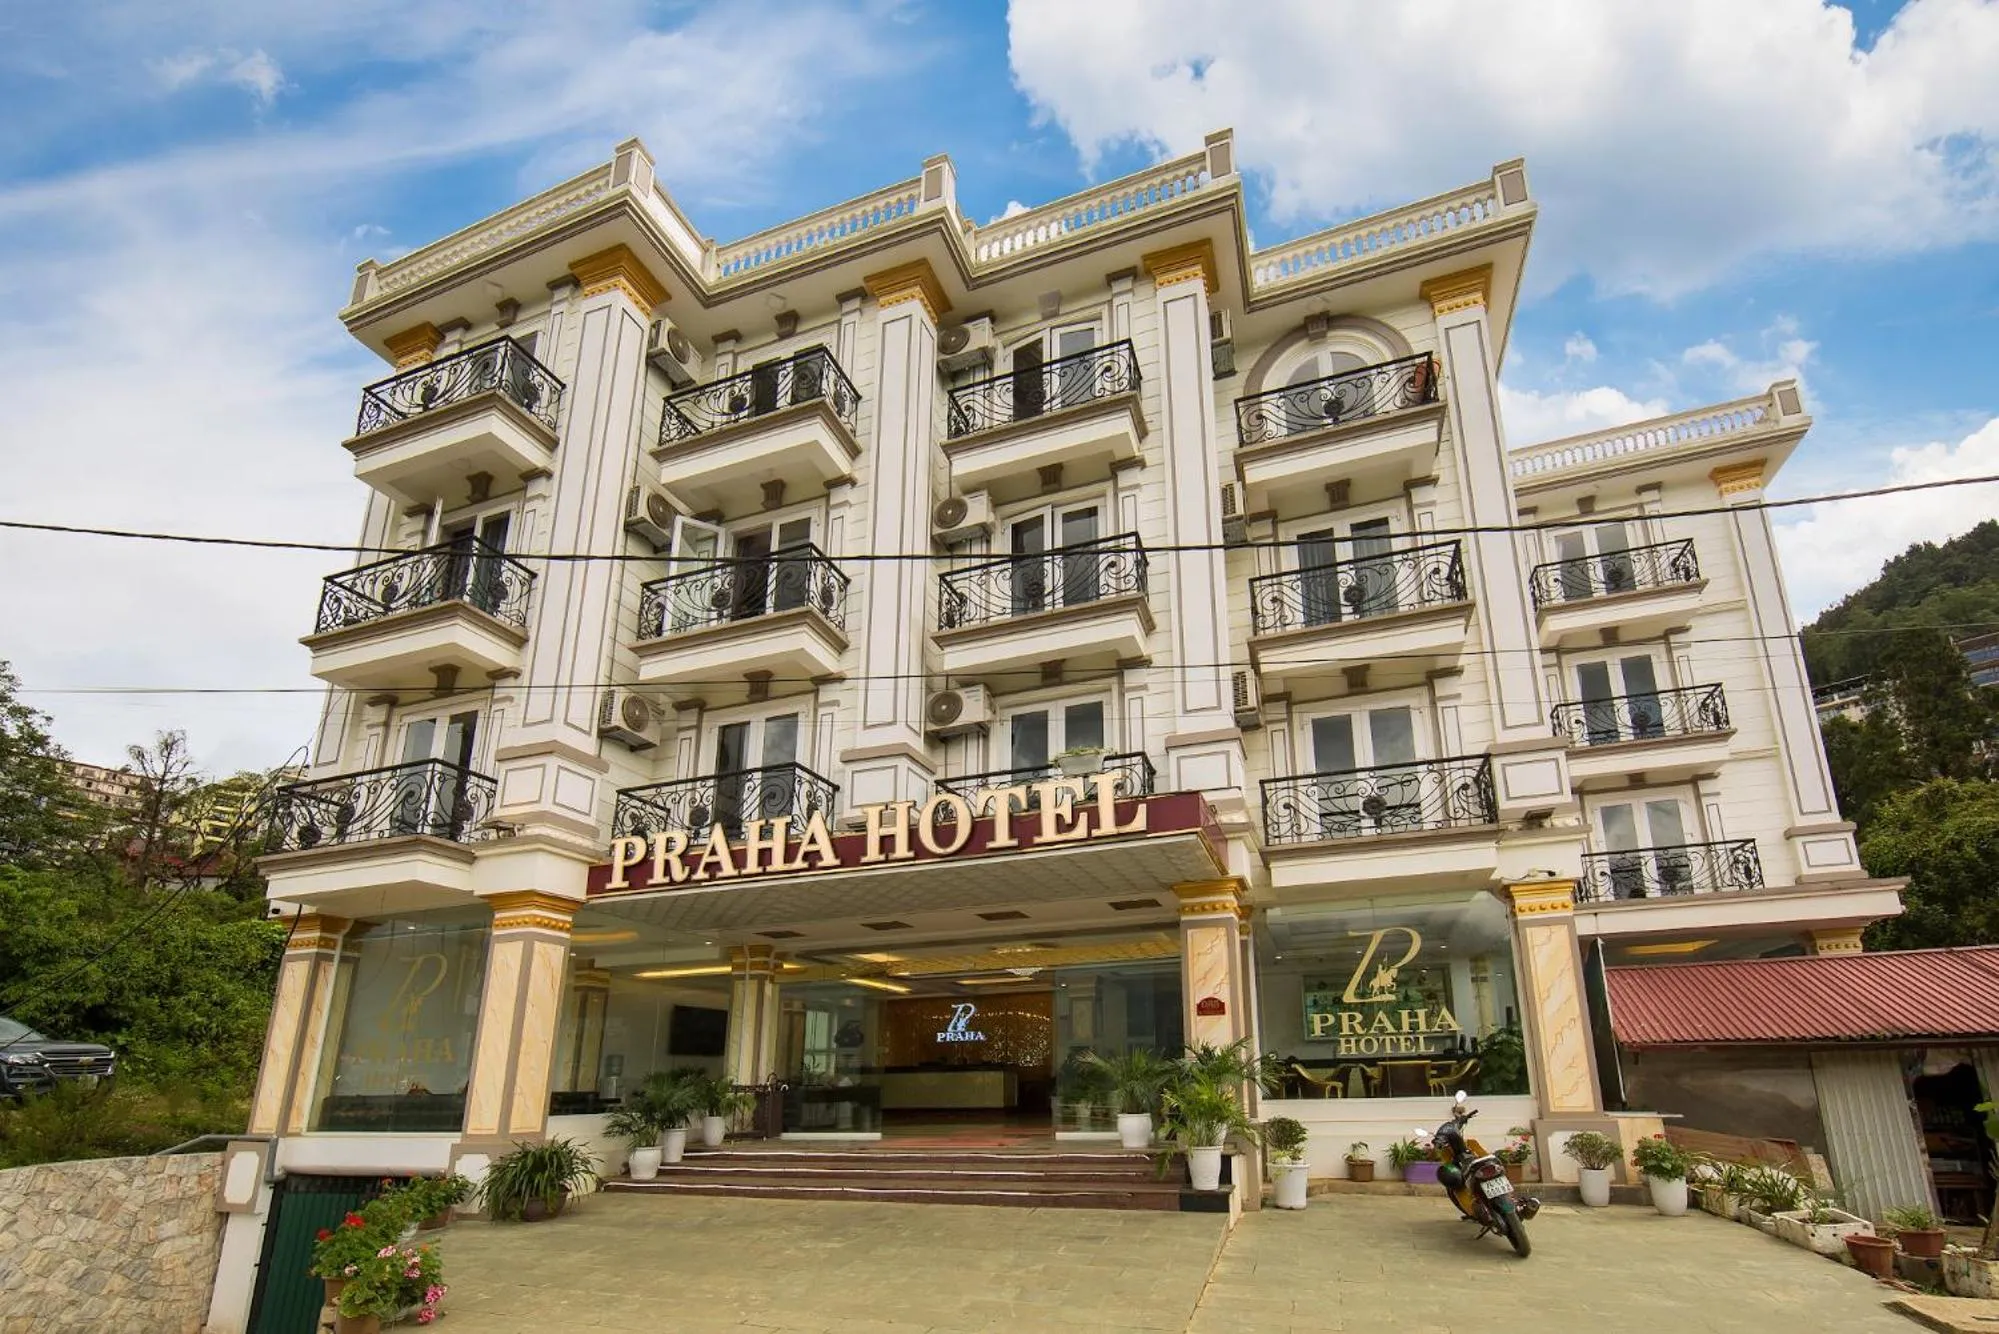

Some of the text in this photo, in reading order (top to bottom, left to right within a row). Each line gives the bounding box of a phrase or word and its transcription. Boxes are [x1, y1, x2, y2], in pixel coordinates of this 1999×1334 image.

[605, 772, 1149, 890] PRAHA HOTEL
[1309, 1006, 1463, 1038] PRAHA
[937, 1031, 985, 1042] PRAHA
[1339, 1034, 1436, 1056] HOTEL
